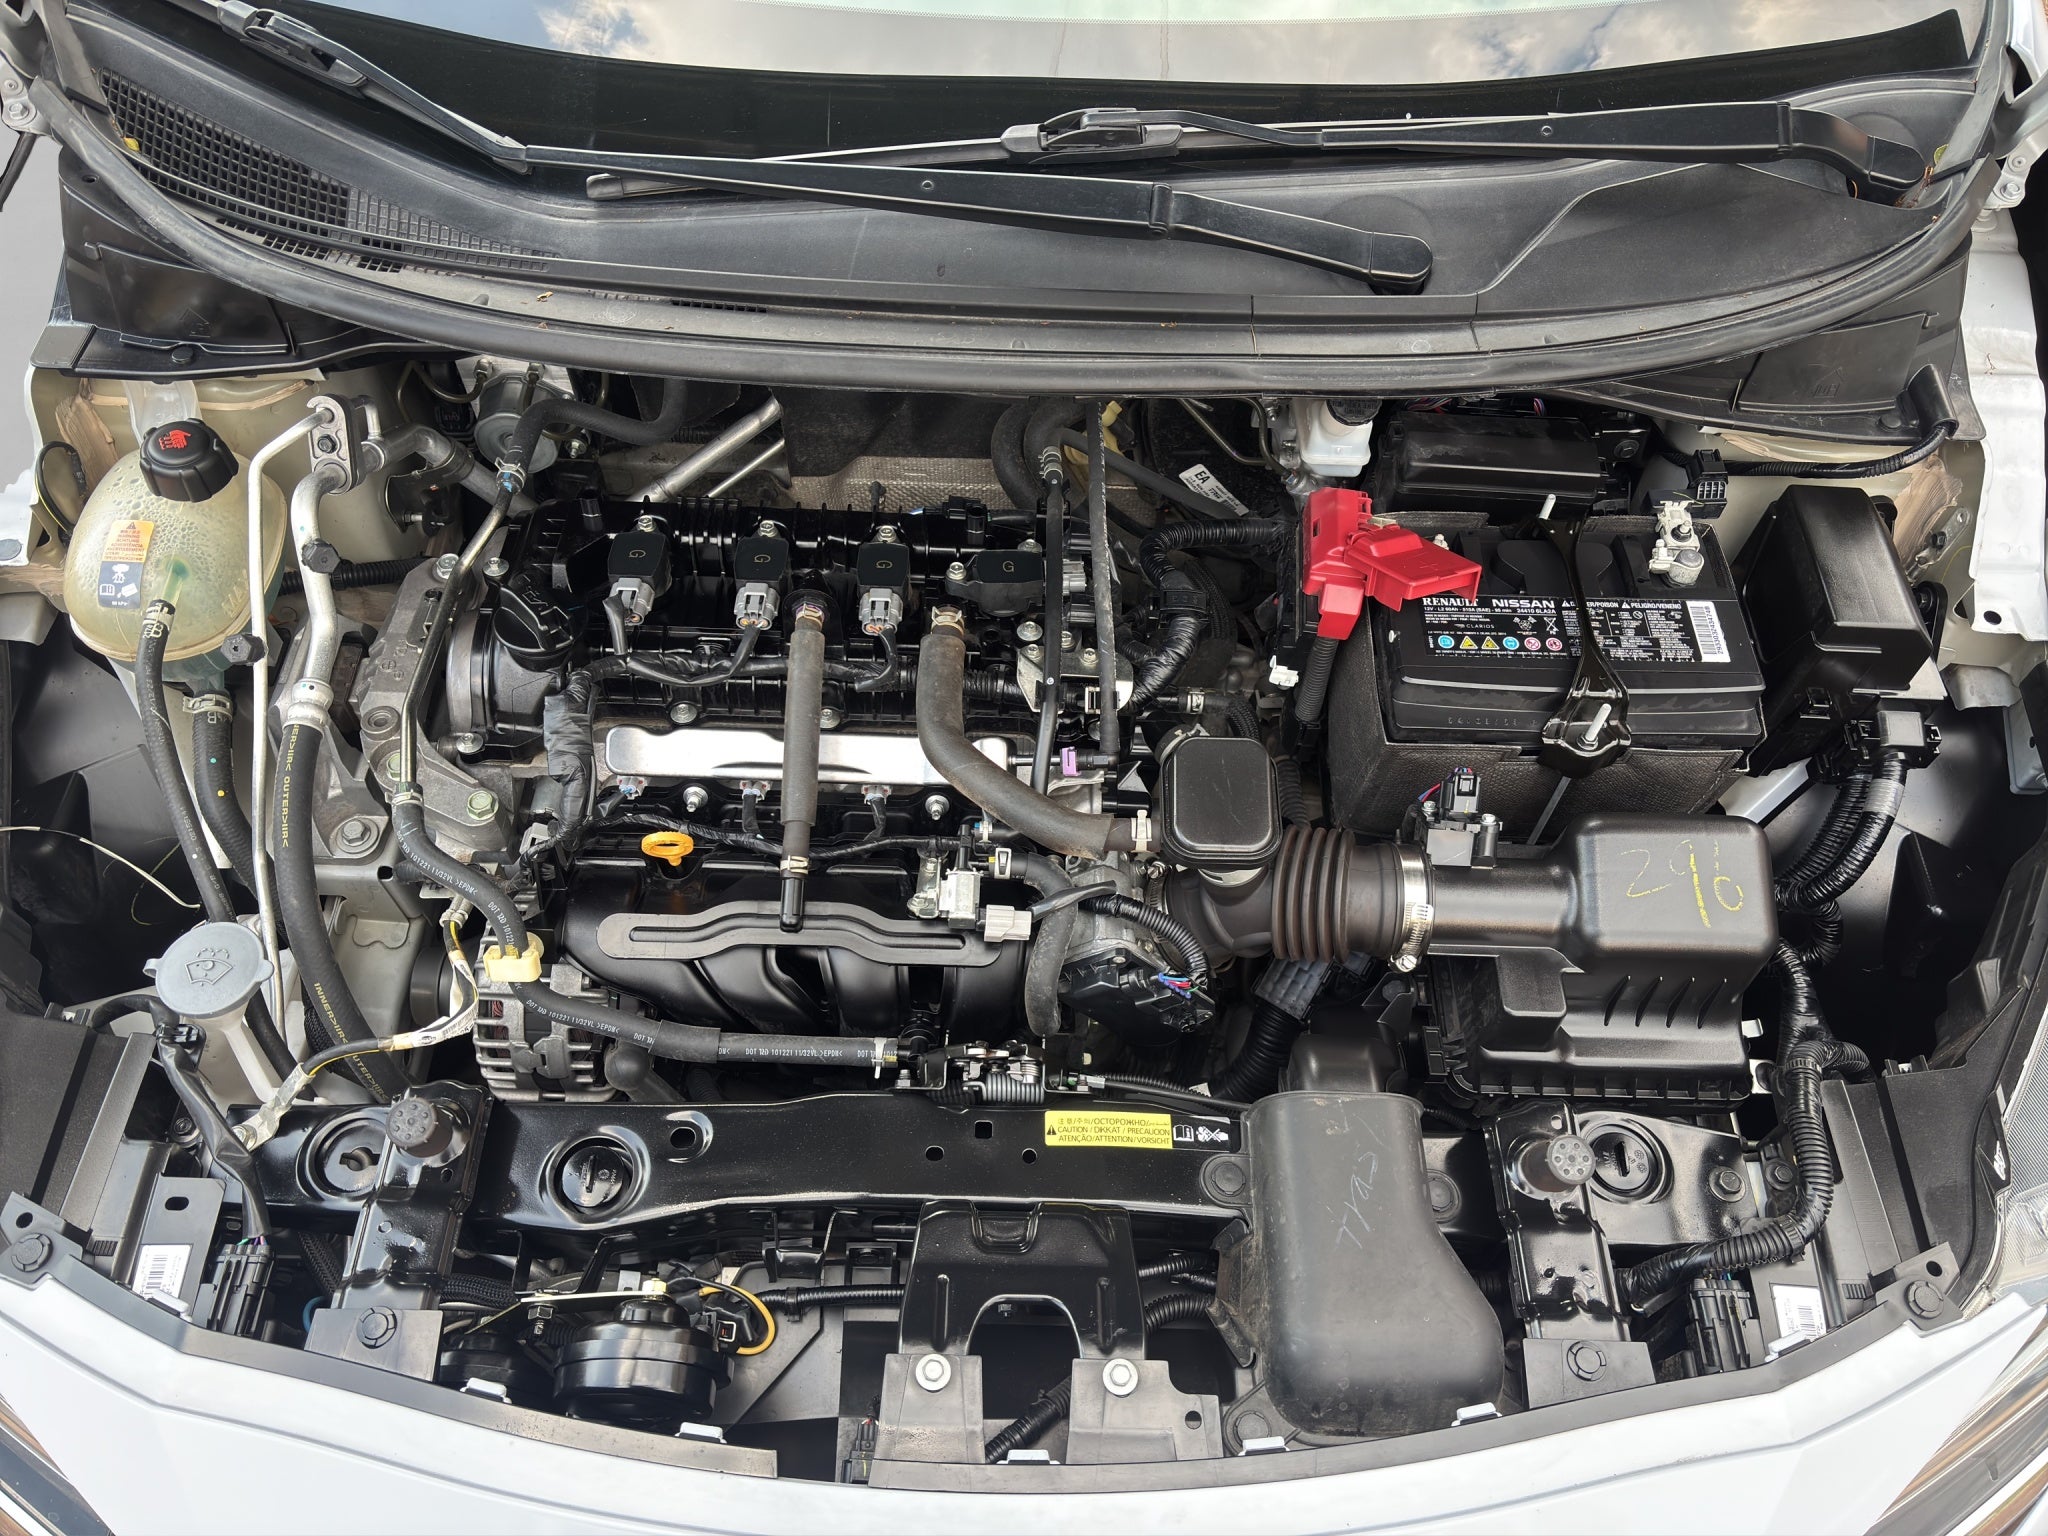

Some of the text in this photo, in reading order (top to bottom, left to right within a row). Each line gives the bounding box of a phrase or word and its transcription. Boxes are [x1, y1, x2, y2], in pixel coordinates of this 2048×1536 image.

[1194, 470, 1211, 484] EA
[628, 549, 646, 559] G
[753, 554, 771, 563] G
[876, 560, 894, 569] G
[1002, 560, 1015, 573] G
[1422, 597, 1479, 607] RENAULT
[1491, 598, 1556, 609] NISSAN
[487, 901, 500, 914] DOT
[525, 999, 538, 1009] DOT
[548, 1010, 570, 1022] 101221
[596, 1021, 620, 1034] >EPDM<
[633, 1032, 646, 1041] DOT
[745, 1047, 757, 1056] DOT
[771, 1048, 793, 1057] 101221
[818, 1049, 843, 1057] >EPDM<
[857, 1050, 868, 1058] DOT
[352, 1055, 390, 1100] UTER>IIR<
[1057, 1126, 1089, 1134] CAUTION
